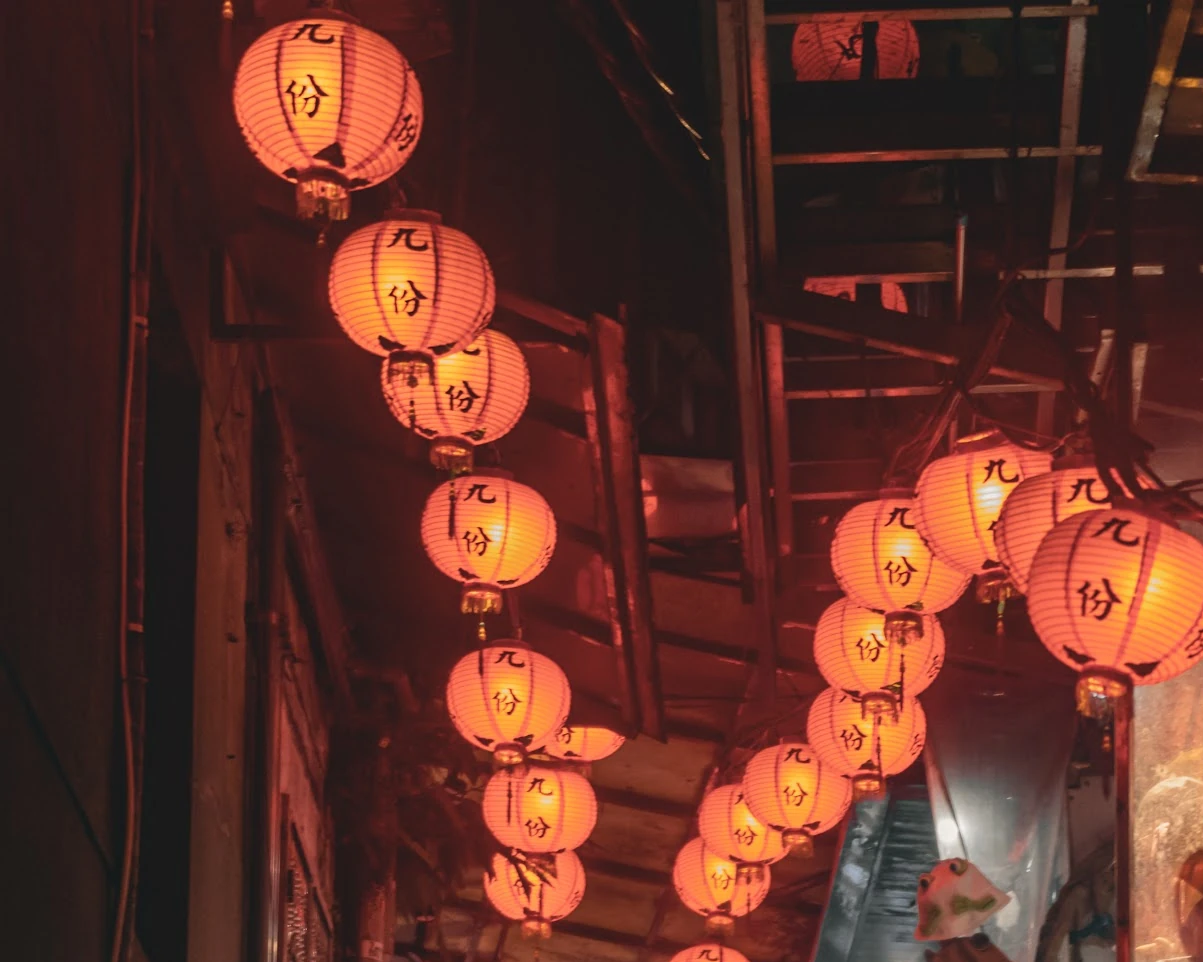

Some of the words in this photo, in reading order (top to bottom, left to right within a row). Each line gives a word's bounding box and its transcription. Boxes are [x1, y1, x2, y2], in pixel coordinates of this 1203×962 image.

[285, 23, 335, 119] 九份
[387, 228, 429, 317] 九份
[462, 484, 497, 557] 九份
[884, 506, 918, 588] 九份
[1077, 516, 1141, 621] 九份
[492, 650, 526, 716] 九份
[855, 632, 887, 662] 份
[525, 777, 553, 838] 九份
[783, 748, 812, 807] 九份
